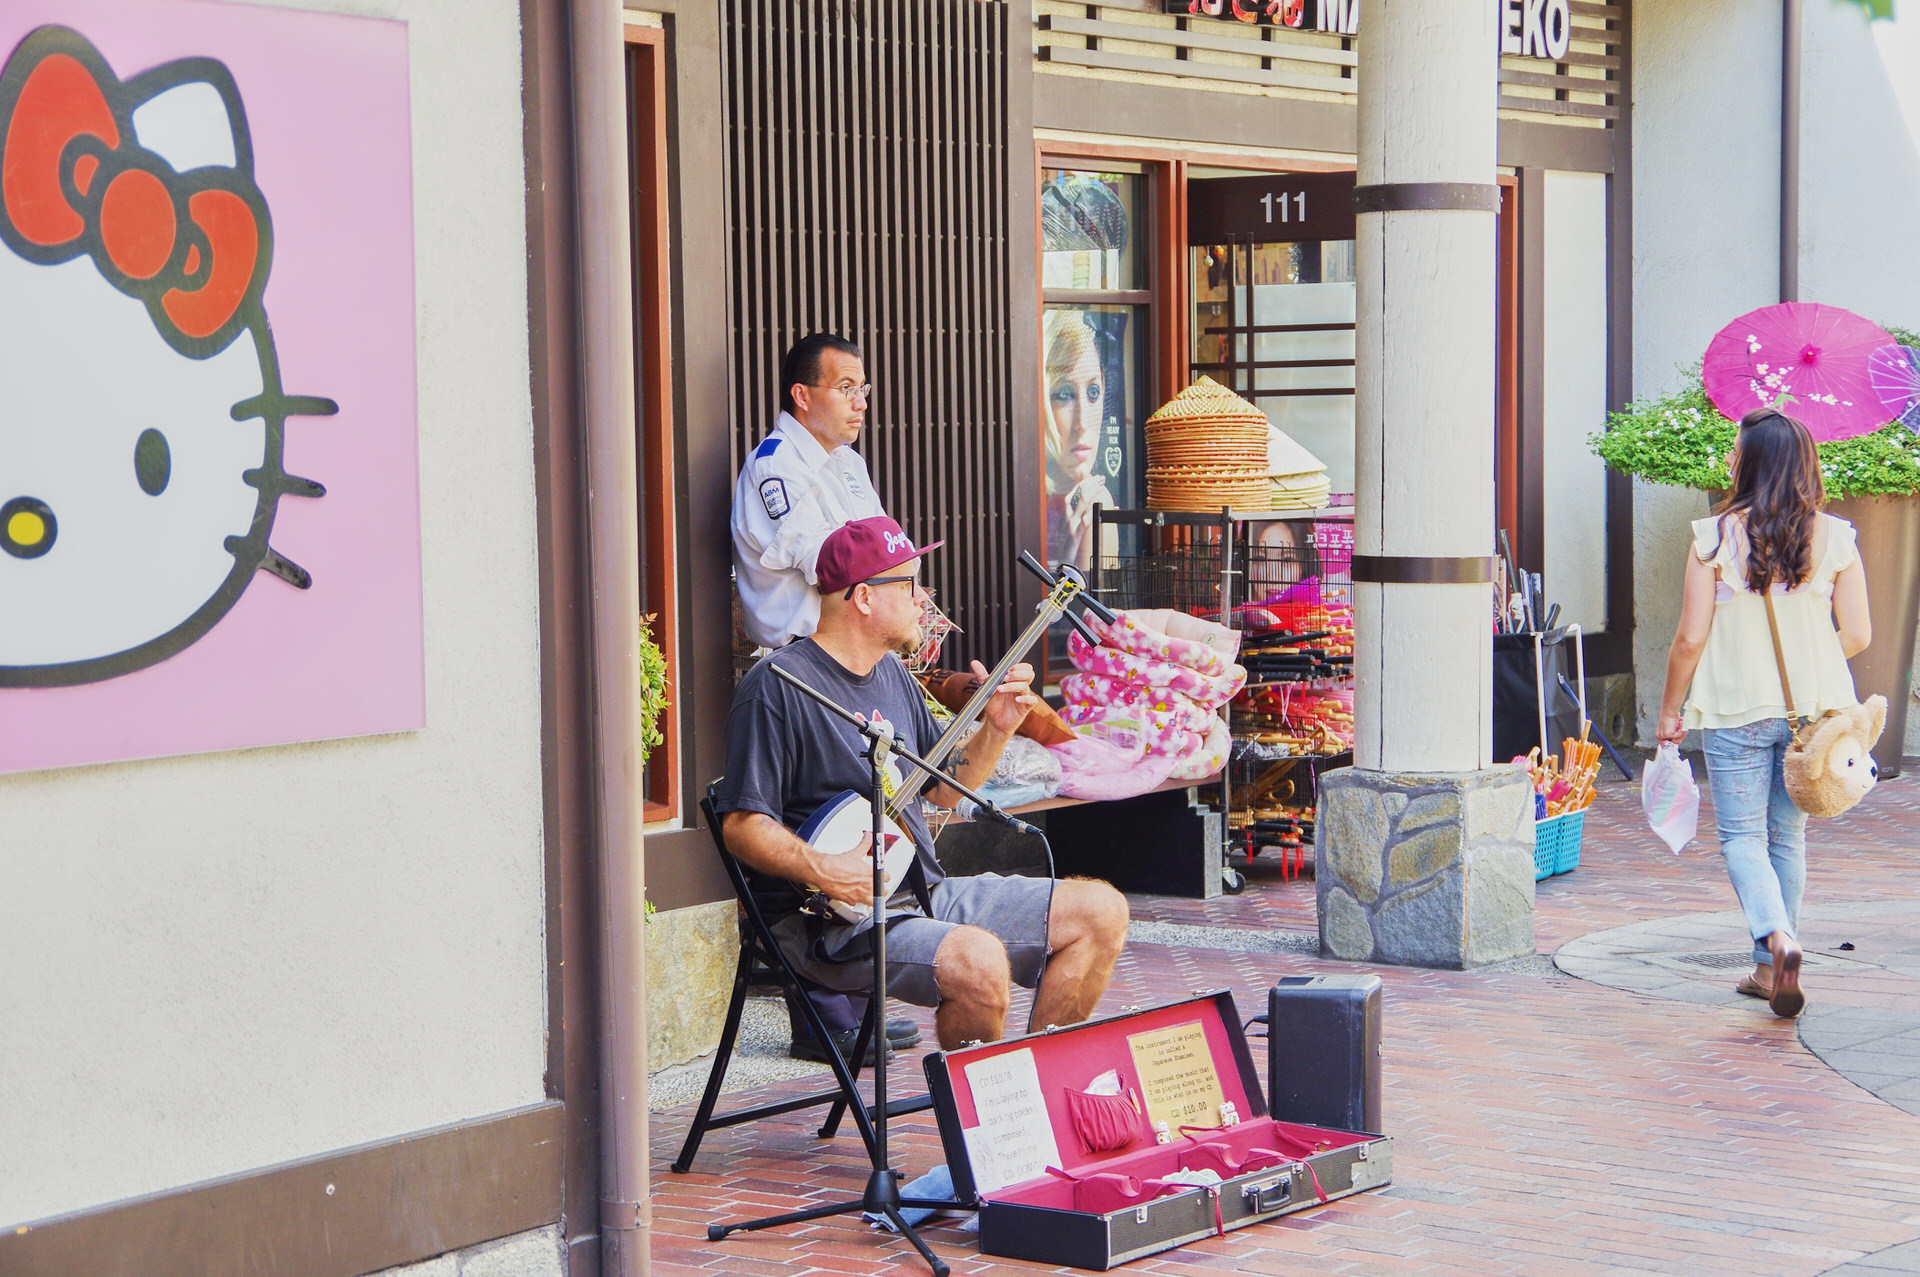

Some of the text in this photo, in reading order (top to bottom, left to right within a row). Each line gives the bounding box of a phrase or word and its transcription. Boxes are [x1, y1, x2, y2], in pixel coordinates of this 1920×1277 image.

[1260, 191, 1305, 223] 111
[1162, 1084, 1180, 1093] playing
[1183, 1101, 1207, 1115] $10.00
